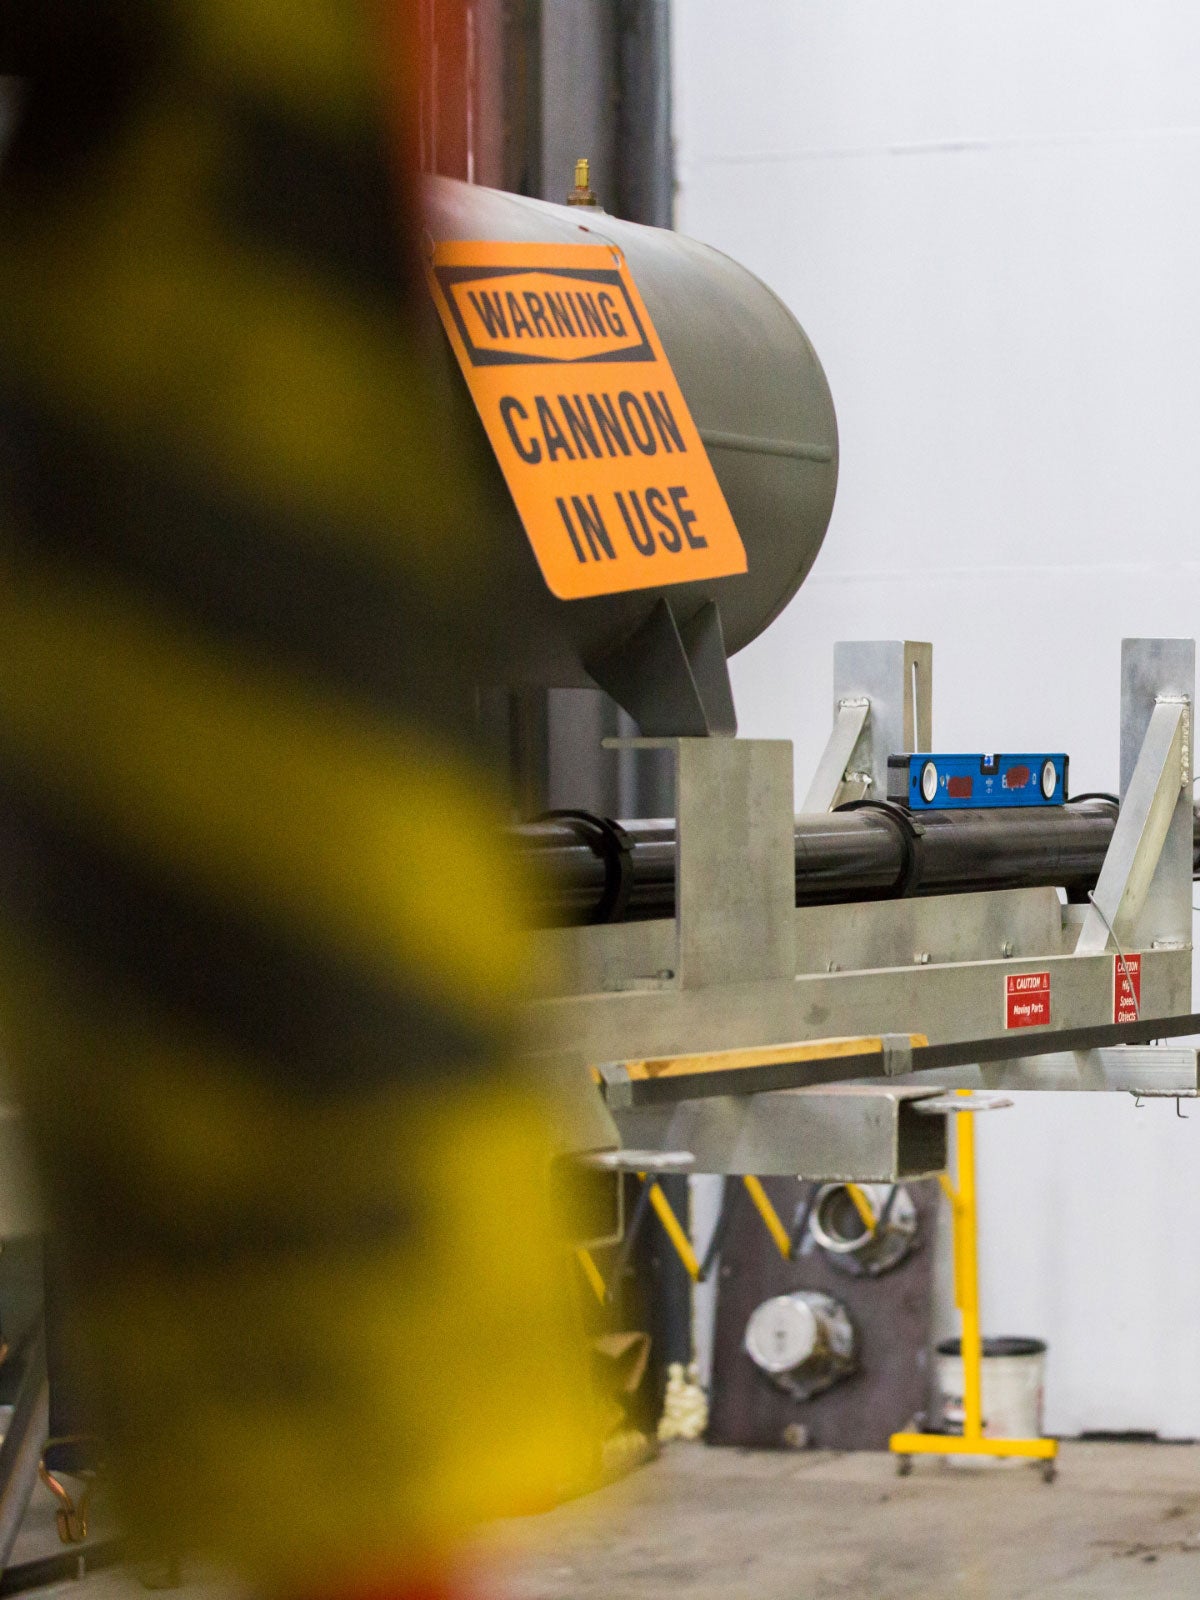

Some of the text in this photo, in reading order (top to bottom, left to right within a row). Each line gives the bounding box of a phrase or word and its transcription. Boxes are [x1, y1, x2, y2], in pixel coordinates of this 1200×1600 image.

[467, 291, 628, 339] WARNING
[499, 391, 687, 464] CANNON
[555, 485, 708, 563] IN USE
[1016, 976, 1041, 990] CAUTION
[1013, 1002, 1044, 1017] Moving Parts
